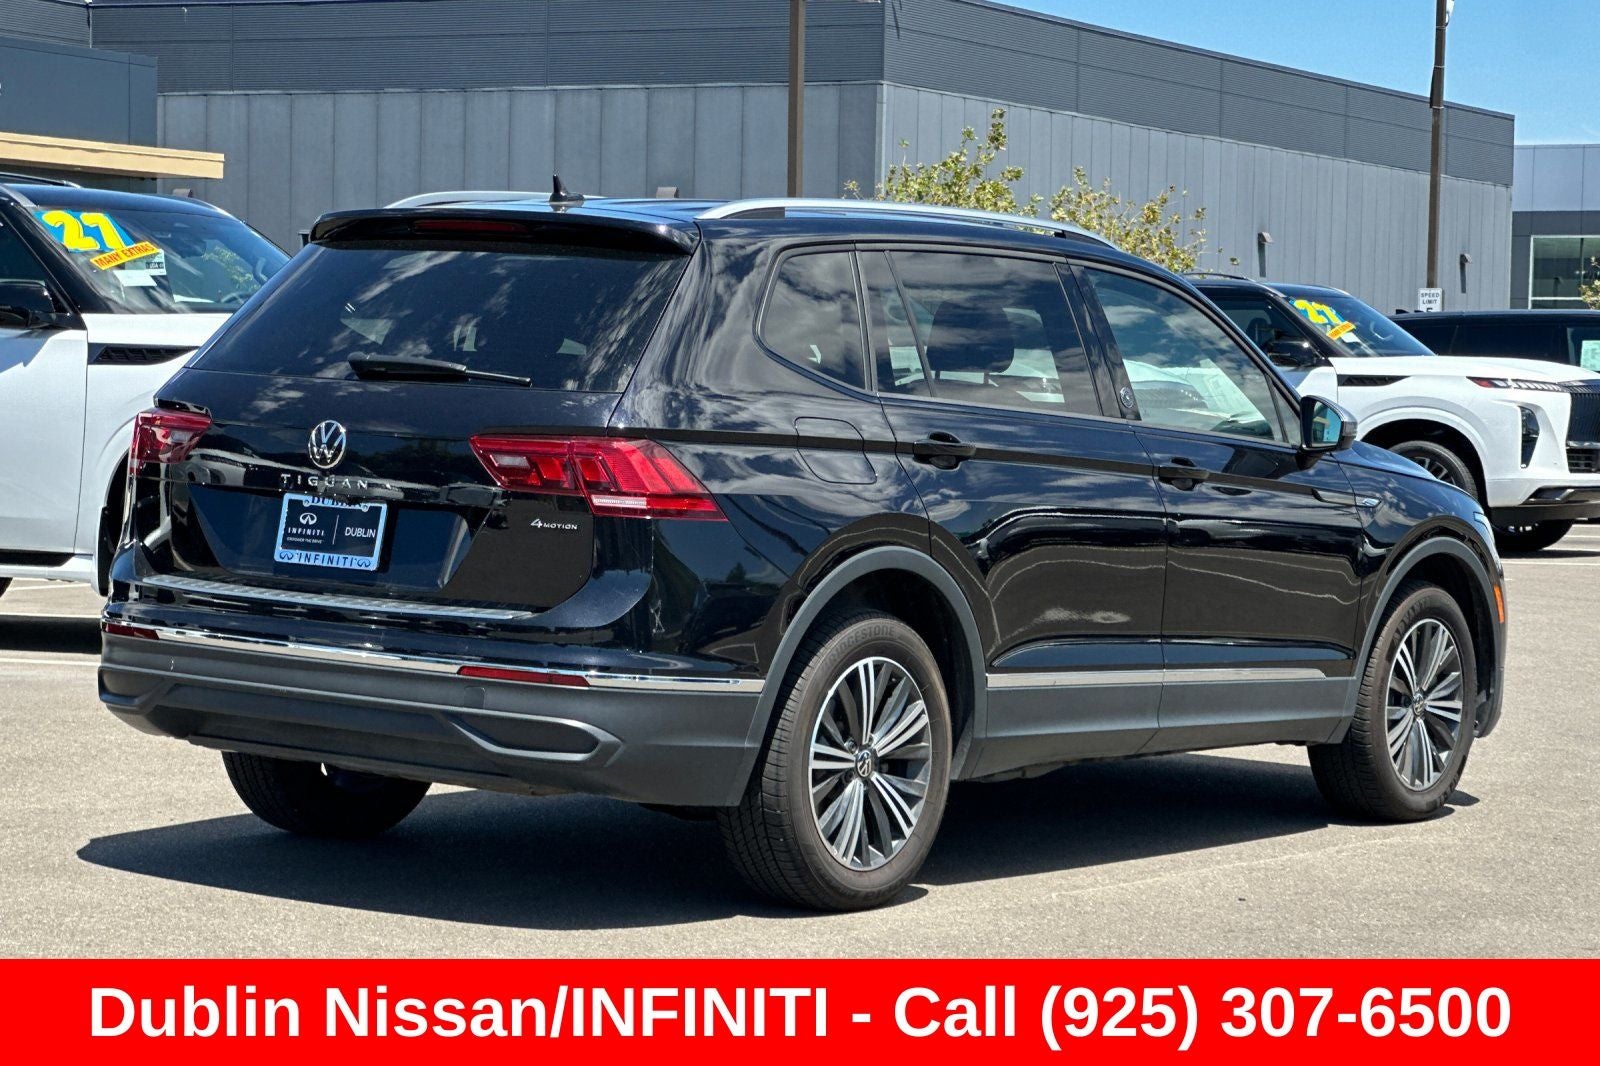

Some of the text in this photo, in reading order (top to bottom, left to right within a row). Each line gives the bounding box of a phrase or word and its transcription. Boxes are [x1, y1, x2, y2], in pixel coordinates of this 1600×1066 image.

[94, 243, 156, 267] MANY EXTRAS
[280, 473, 368, 490] TIGUAN
[530, 518, 578, 530] 4MOTION
[288, 527, 325, 537] INFINITI
[344, 526, 376, 538] DUBLIN
[298, 553, 354, 567] INFINITI
